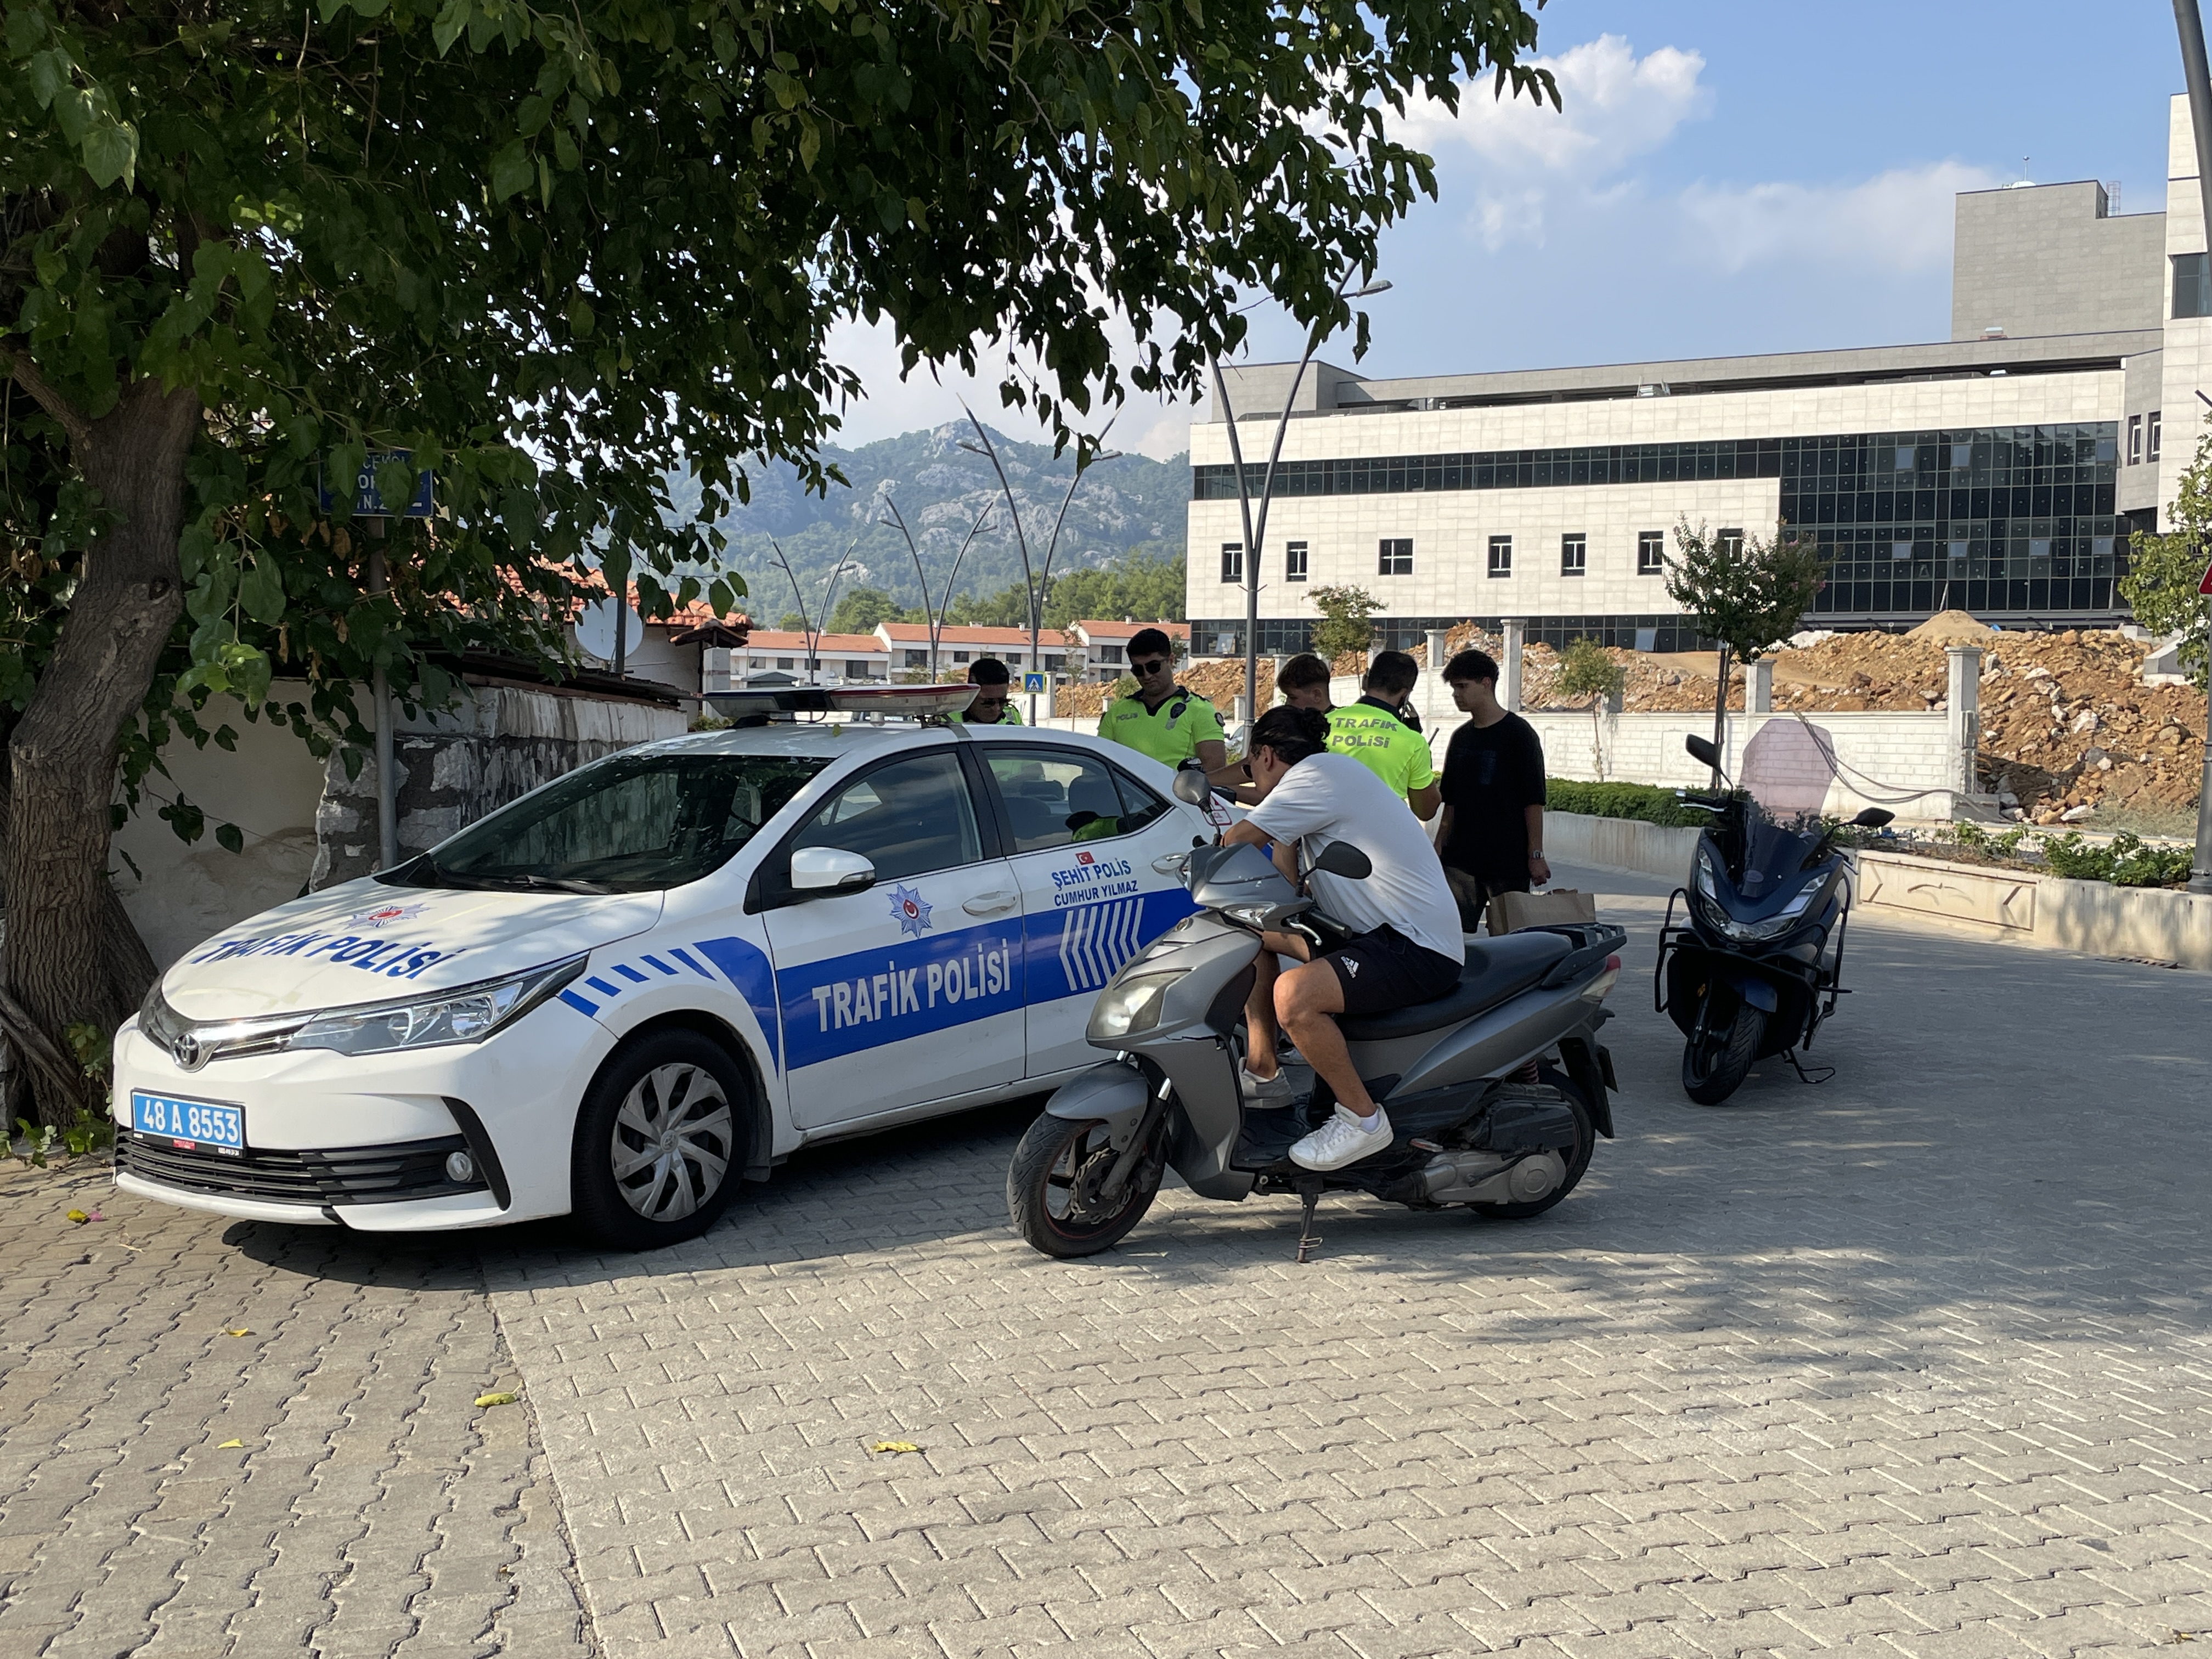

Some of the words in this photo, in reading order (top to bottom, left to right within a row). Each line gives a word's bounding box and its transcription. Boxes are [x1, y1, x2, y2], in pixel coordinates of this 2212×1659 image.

[1051, 865, 1091, 891] ŞEHİT
[1092, 857, 1132, 879] POLİS
[1054, 887, 1099, 907] CUMHUR
[1101, 879, 1138, 897] YILMAZ
[190, 930, 334, 964] TRAFİK
[303, 936, 467, 979] POLİSİ
[811, 960, 920, 1032] TRAFİK
[927, 938, 1011, 1008] POLİSİ
[144, 1099, 166, 1131] 48
[171, 1104, 183, 1134] A
[188, 1107, 239, 1143] 8553
